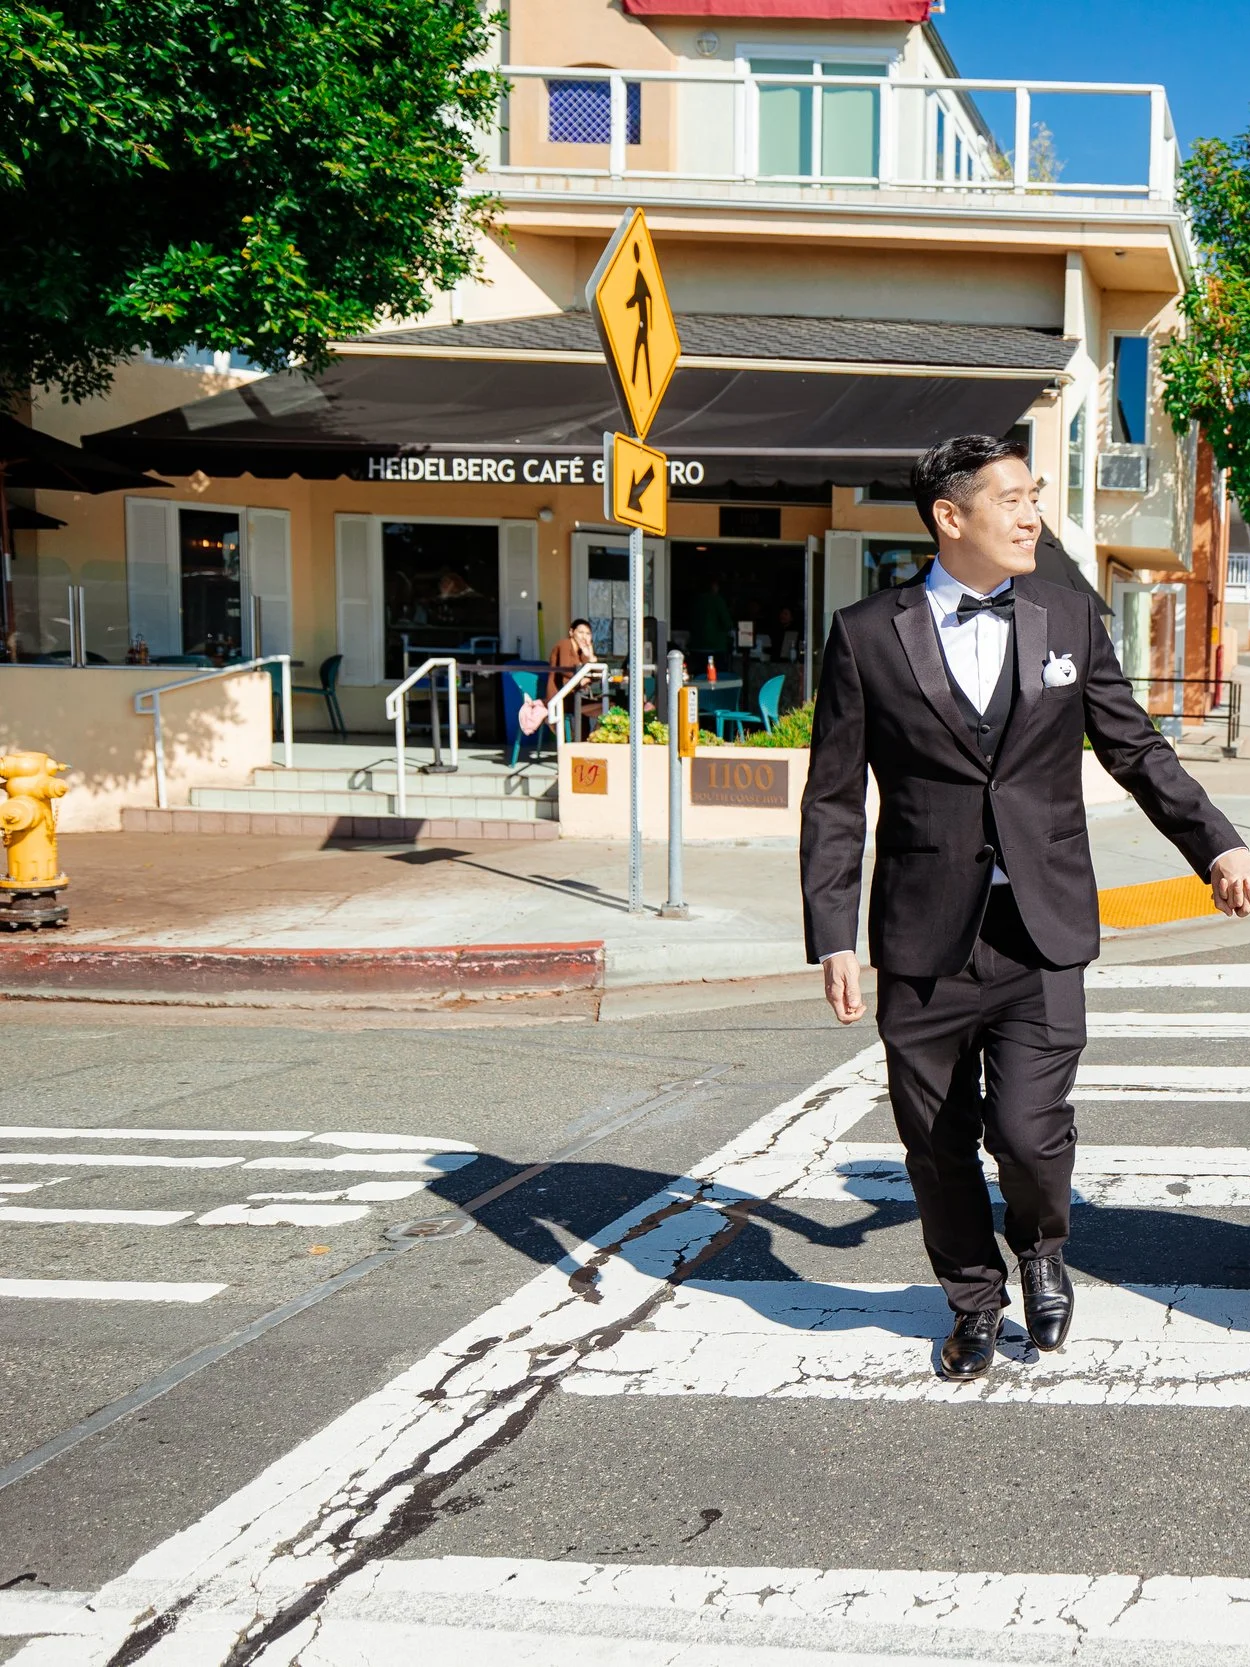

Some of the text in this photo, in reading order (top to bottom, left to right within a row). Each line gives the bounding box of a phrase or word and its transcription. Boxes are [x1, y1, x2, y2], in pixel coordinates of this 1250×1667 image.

[368, 457, 515, 482] HEIDELBERG
[524, 457, 584, 483] CAFÉ
[707, 762, 775, 791] 1100
